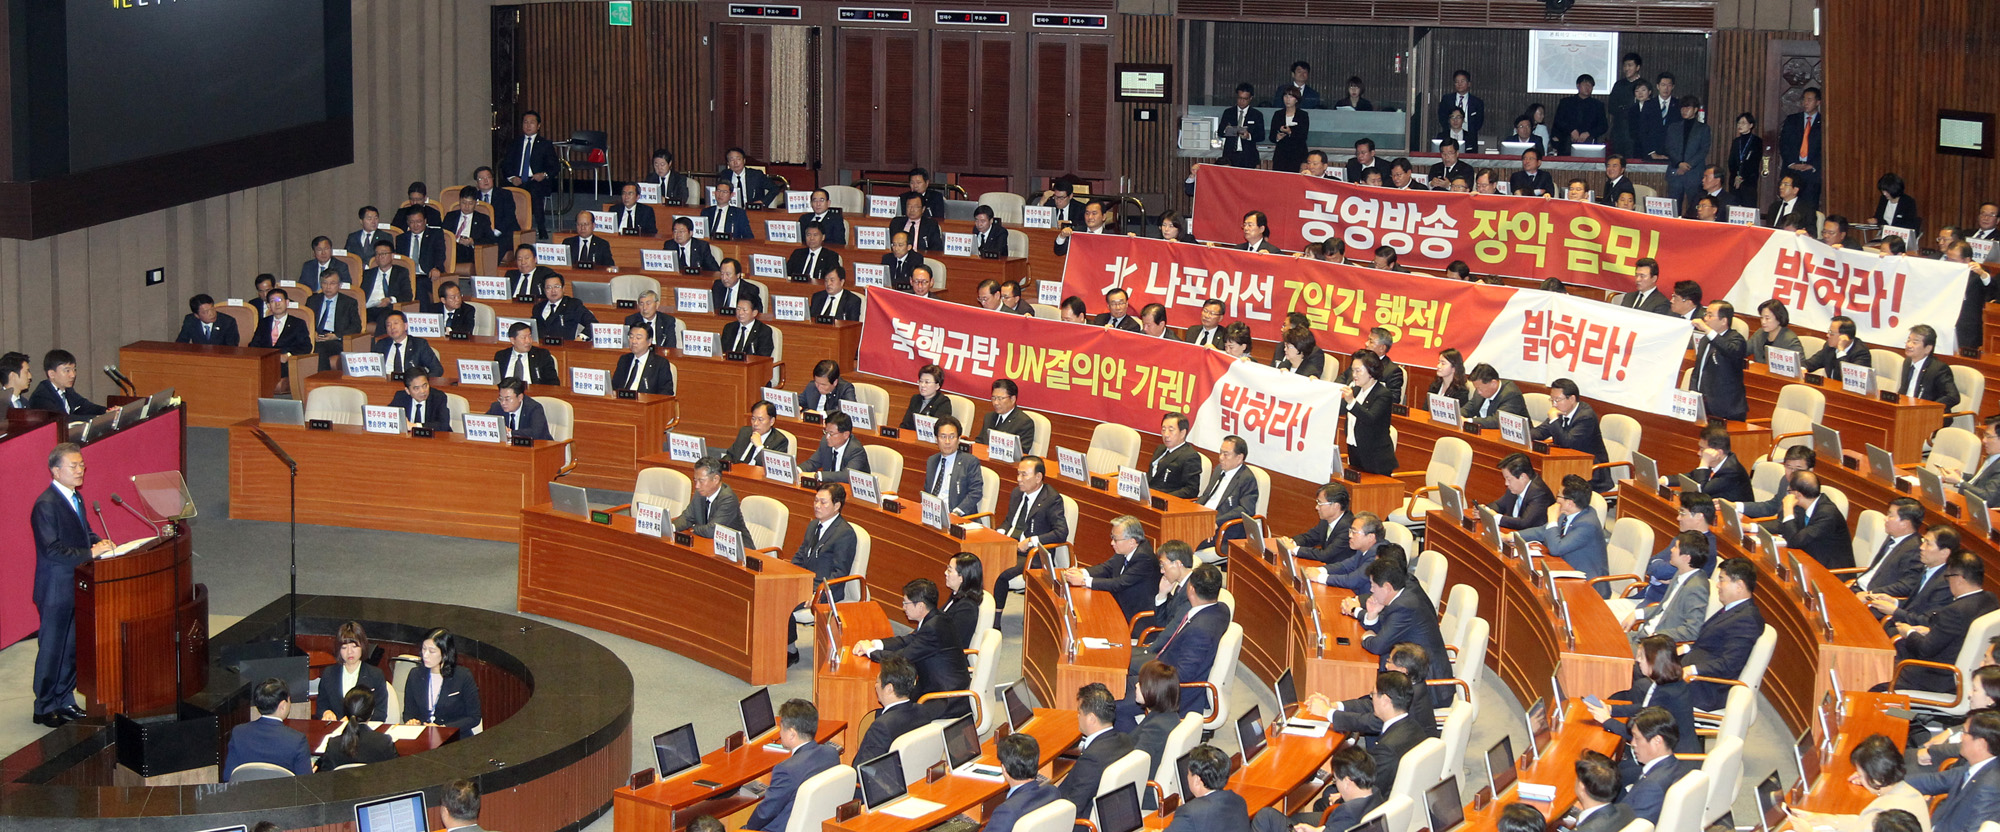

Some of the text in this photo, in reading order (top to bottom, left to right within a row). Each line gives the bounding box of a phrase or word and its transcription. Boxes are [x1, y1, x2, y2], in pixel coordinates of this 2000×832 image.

[755, 257, 771, 265] 민주주의
[1299, 190, 1459, 259] 공영방송
[1469, 210, 1554, 268] 장악
[1773, 248, 1906, 329] 밝혀라!
[856, 267, 873, 275] 민주주의
[679, 291, 696, 299] 민주주의
[679, 300, 696, 308] 방송장악
[776, 299, 803, 308] 민주주의 유린
[777, 308, 793, 316] 방송장악
[1101, 256, 1638, 382] 北 나포어선 7일간 행적! 밝혀라!
[612, 327, 621, 335] 유린
[684, 334, 711, 343] 민주주의 유린
[684, 343, 701, 351] 방송장악
[347, 356, 367, 364] 민주주의
[460, 363, 479, 371] 민주주의
[574, 371, 603, 381] 민주주의 유린
[574, 381, 603, 391] 방송장악 저지
[890, 317, 1314, 452] 북핵규탄 UN결의안 기권! 밝혀라!
[366, 409, 397, 419] 민주주의 유린
[367, 420, 398, 429] 방송장악 저지
[466, 419, 485, 427] 민주주의
[468, 429, 498, 438] 방송장악 저지
[671, 437, 698, 449] 민주주의 유린
[672, 448, 700, 459] 방송장악 저지
[765, 456, 790, 468] 민주주의 유린
[767, 466, 792, 478] 방송장악 저지
